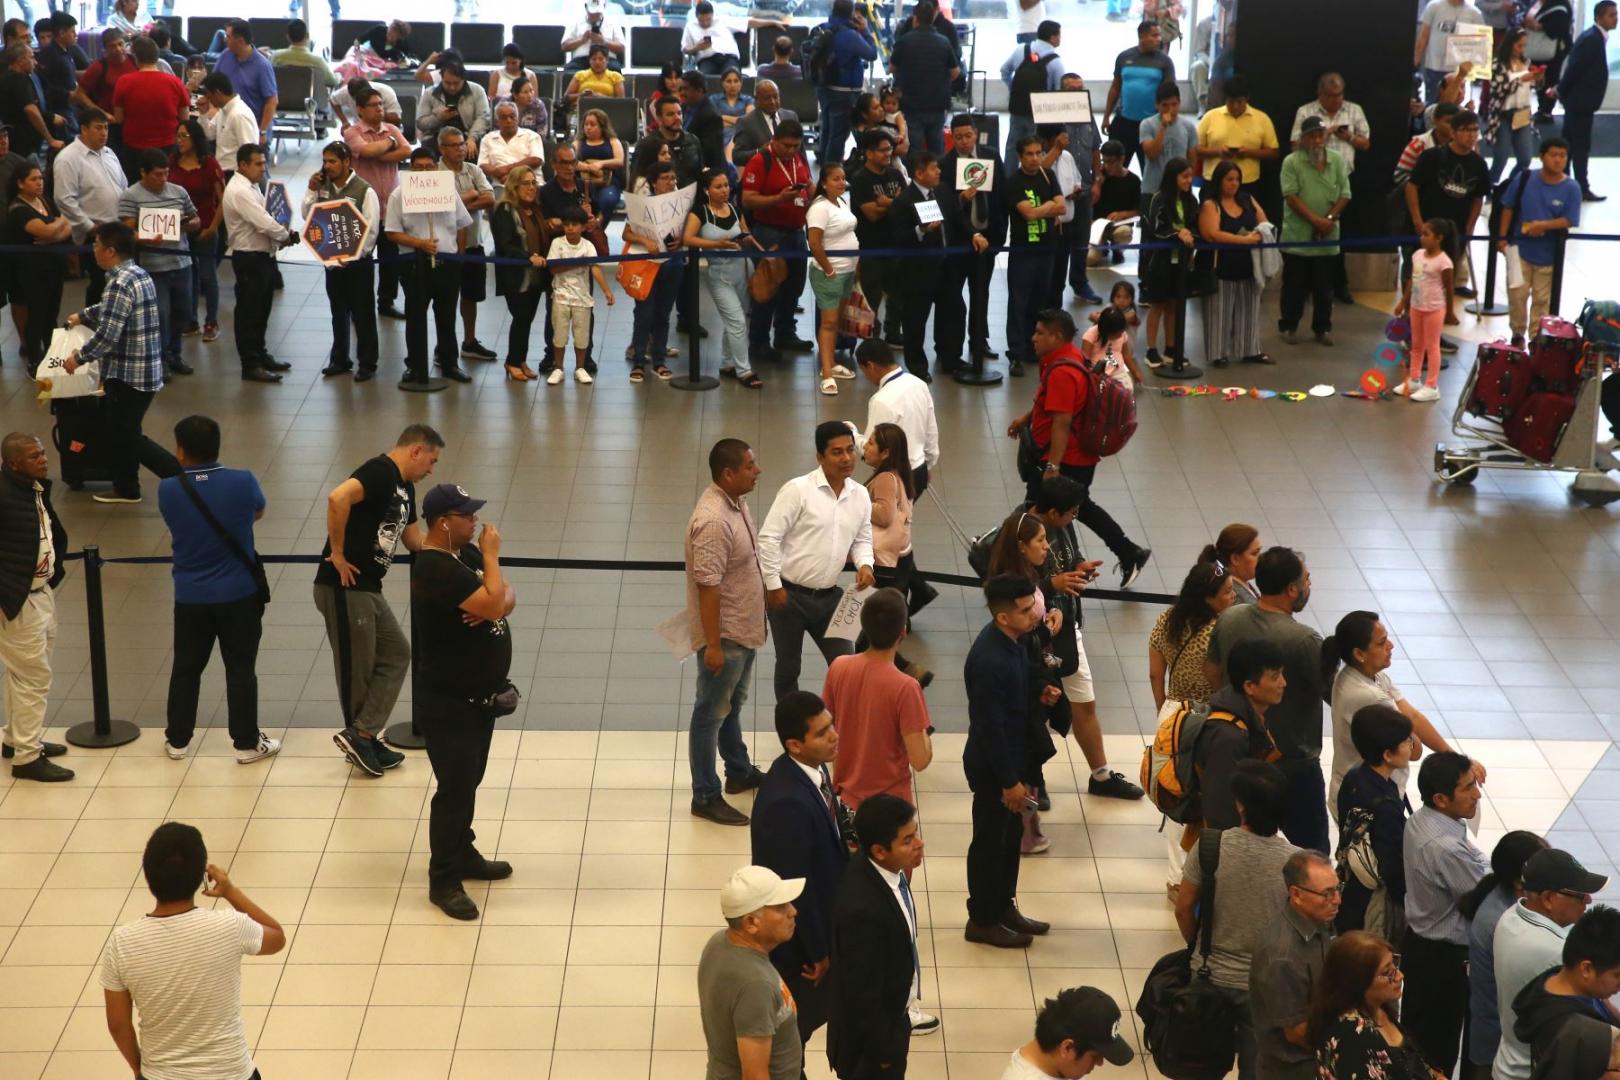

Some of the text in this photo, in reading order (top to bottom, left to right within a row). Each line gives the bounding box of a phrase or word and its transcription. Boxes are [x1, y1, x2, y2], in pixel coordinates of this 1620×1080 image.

[141, 213, 177, 236] CIMA
[331, 213, 340, 223] 2
[843, 597, 863, 625] CHOI
